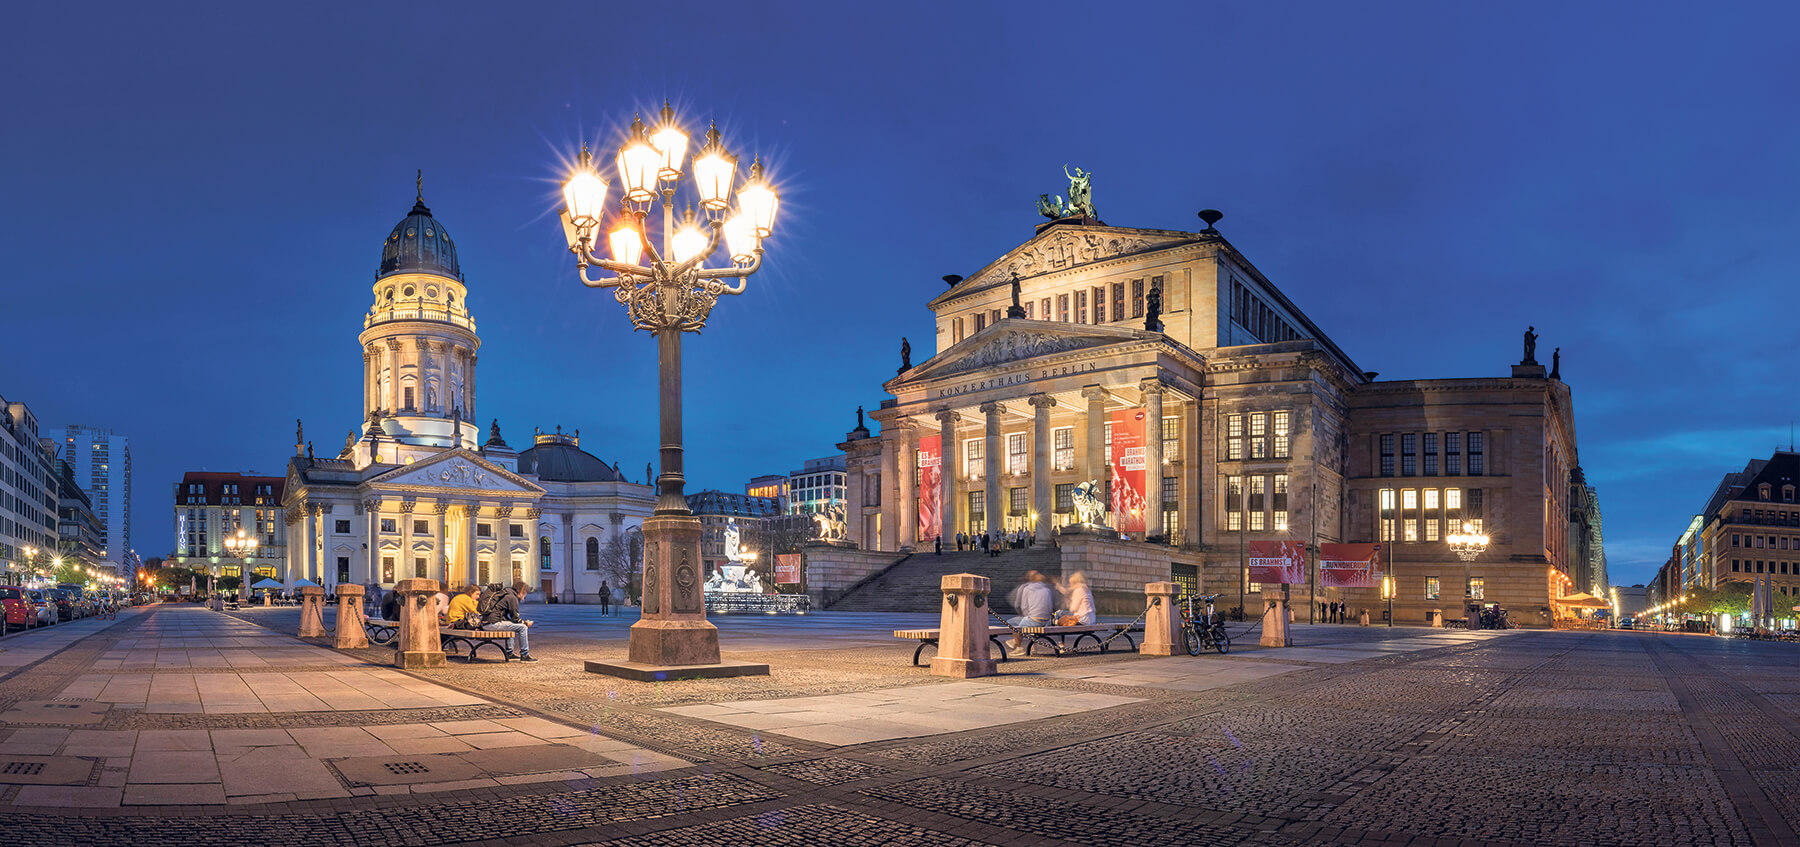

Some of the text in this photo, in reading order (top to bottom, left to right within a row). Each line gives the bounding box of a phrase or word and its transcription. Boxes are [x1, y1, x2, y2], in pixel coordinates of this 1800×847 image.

[938, 362, 1097, 398] KONZERTHAUS BERLIN
[1121, 456, 1145, 465] MARATHON
[1250, 558, 1258, 566] ES
